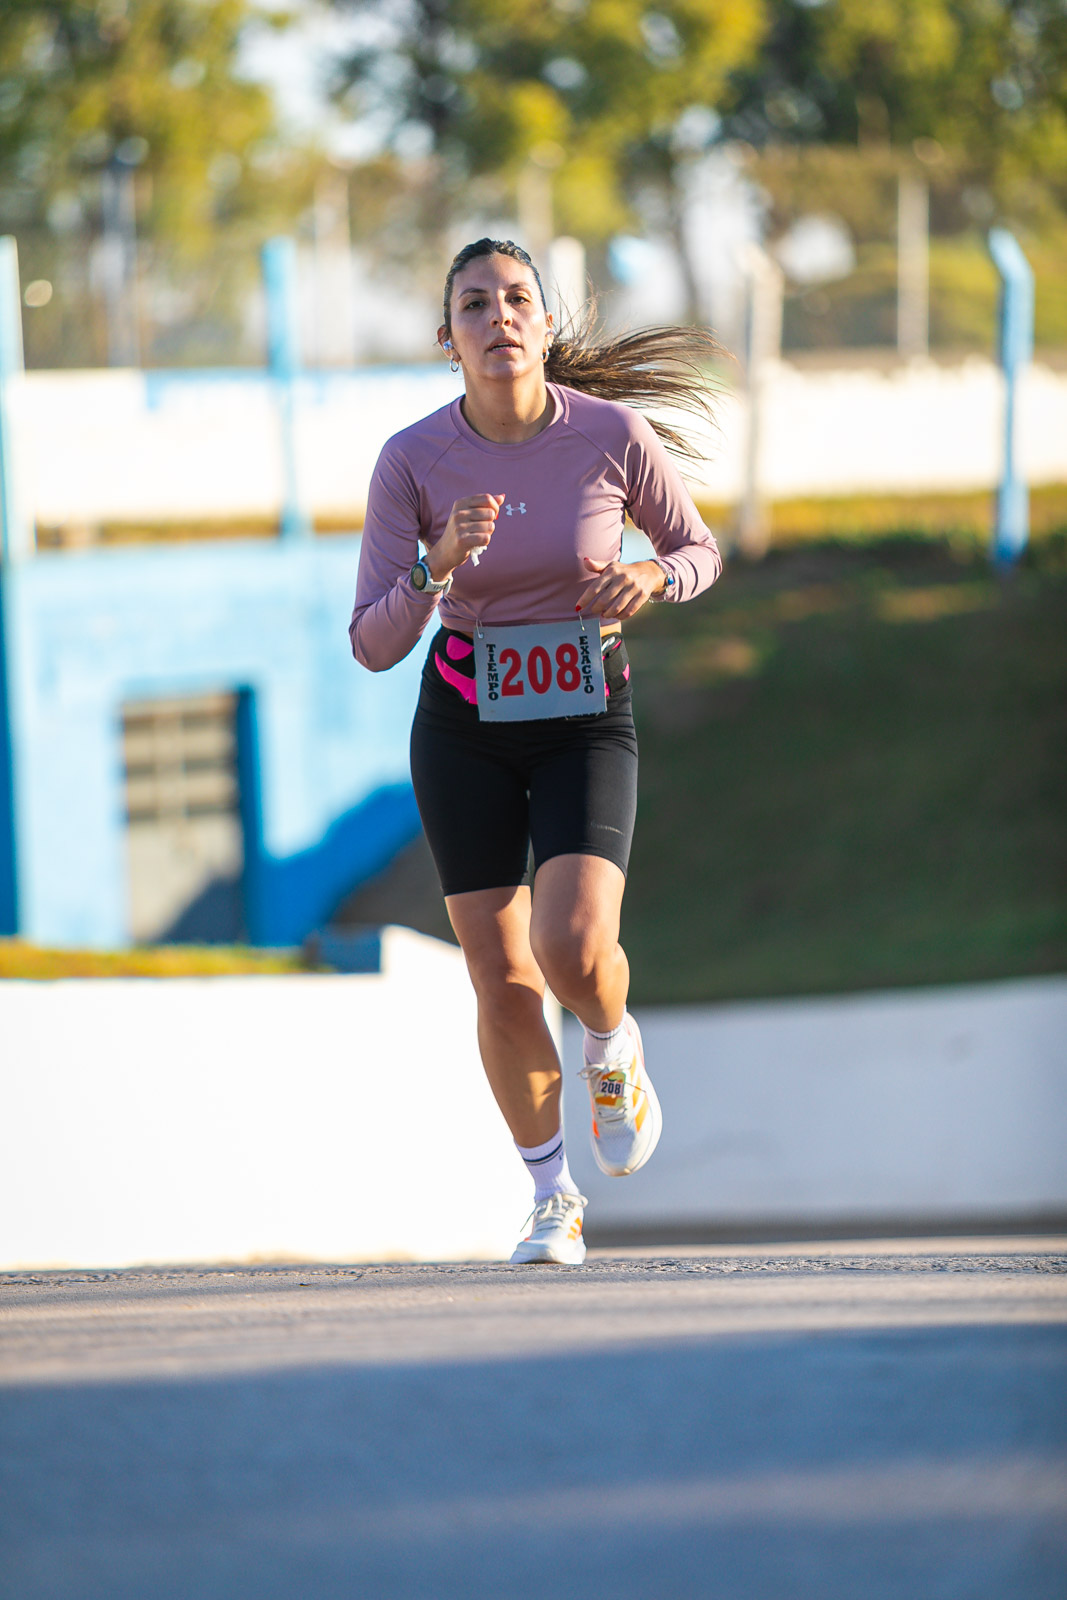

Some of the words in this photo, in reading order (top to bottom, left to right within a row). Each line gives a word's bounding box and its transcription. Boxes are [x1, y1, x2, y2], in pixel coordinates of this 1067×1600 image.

[486, 643, 499, 701] TIEMPO
[499, 643, 581, 697] 208
[579, 635, 594, 694] EXACTO
[601, 1081, 621, 1094] 208
